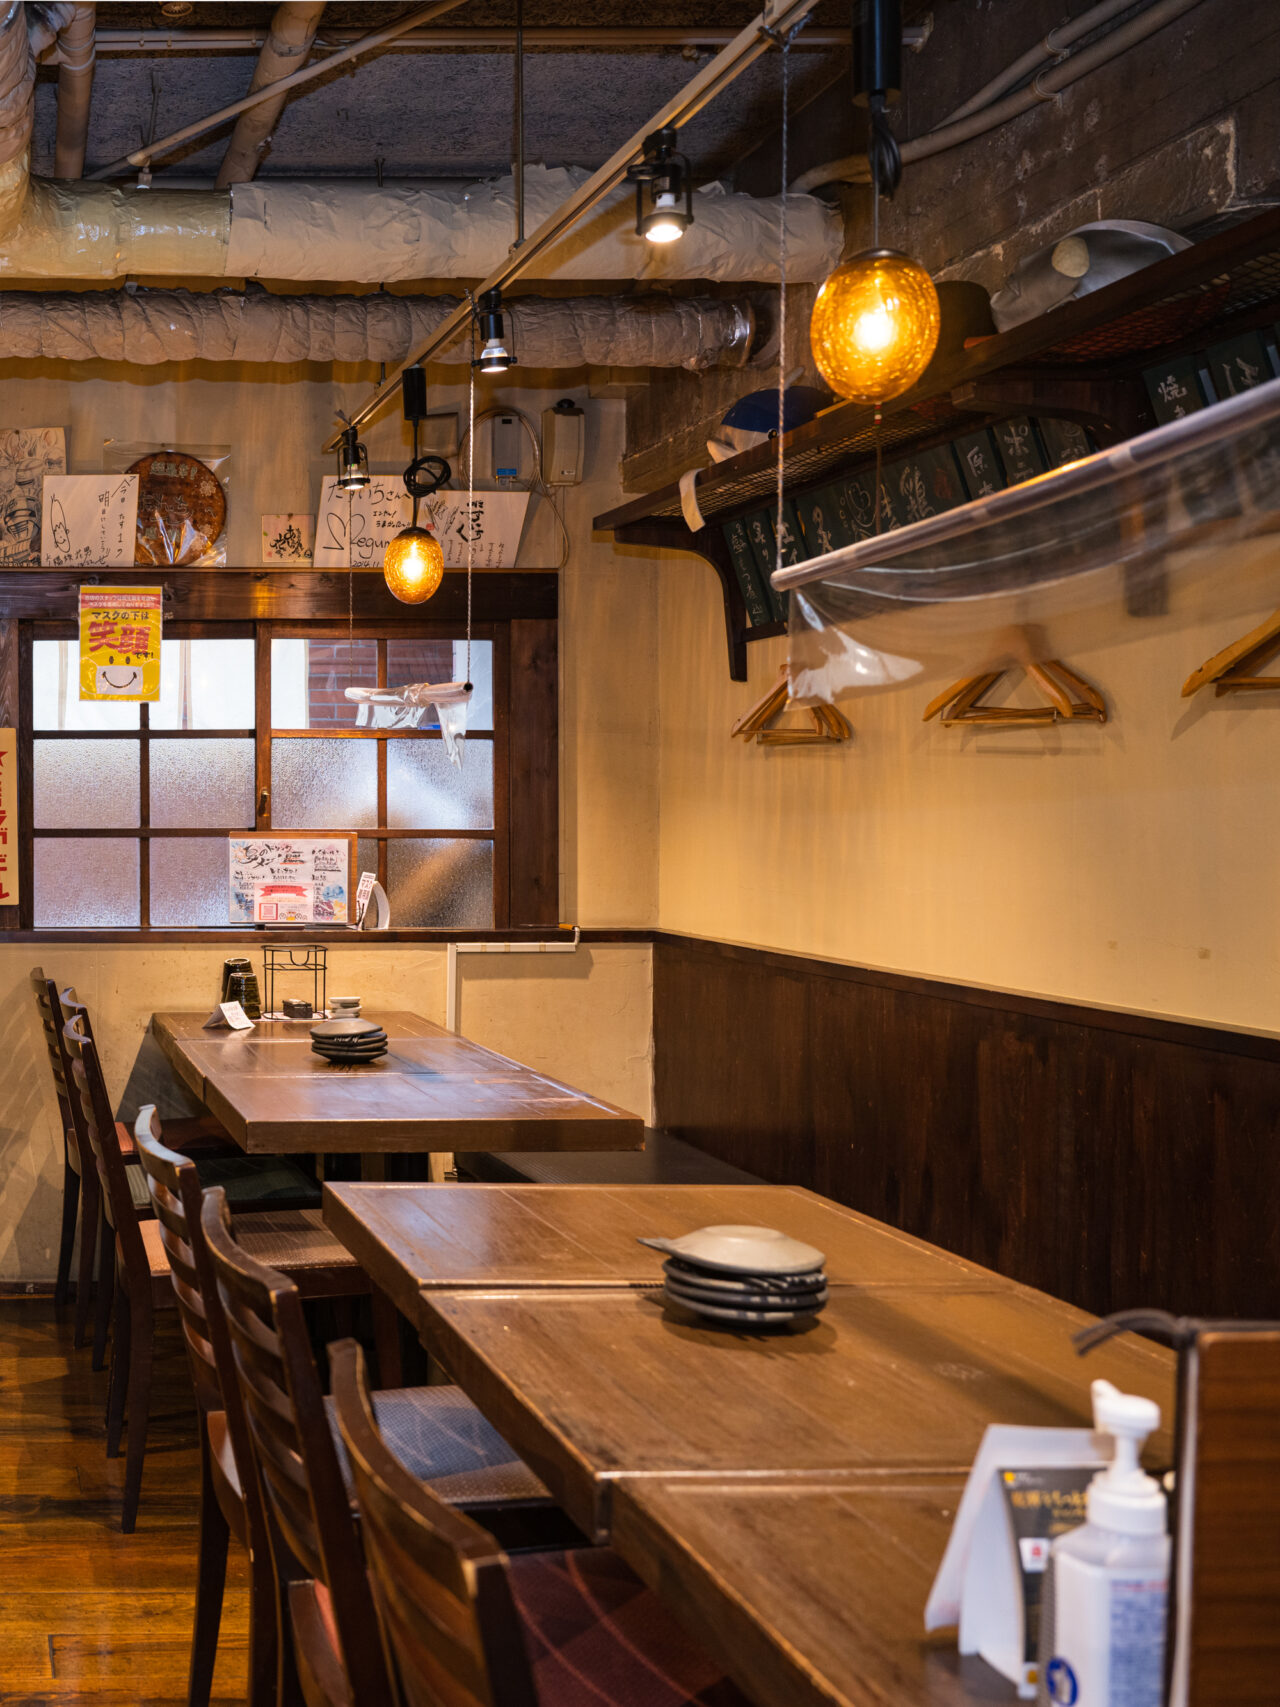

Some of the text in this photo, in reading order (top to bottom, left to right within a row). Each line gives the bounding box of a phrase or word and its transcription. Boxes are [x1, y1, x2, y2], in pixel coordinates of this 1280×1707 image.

[91, 610, 149, 621] マスクの下は
[88, 620, 152, 655] 笑顔
